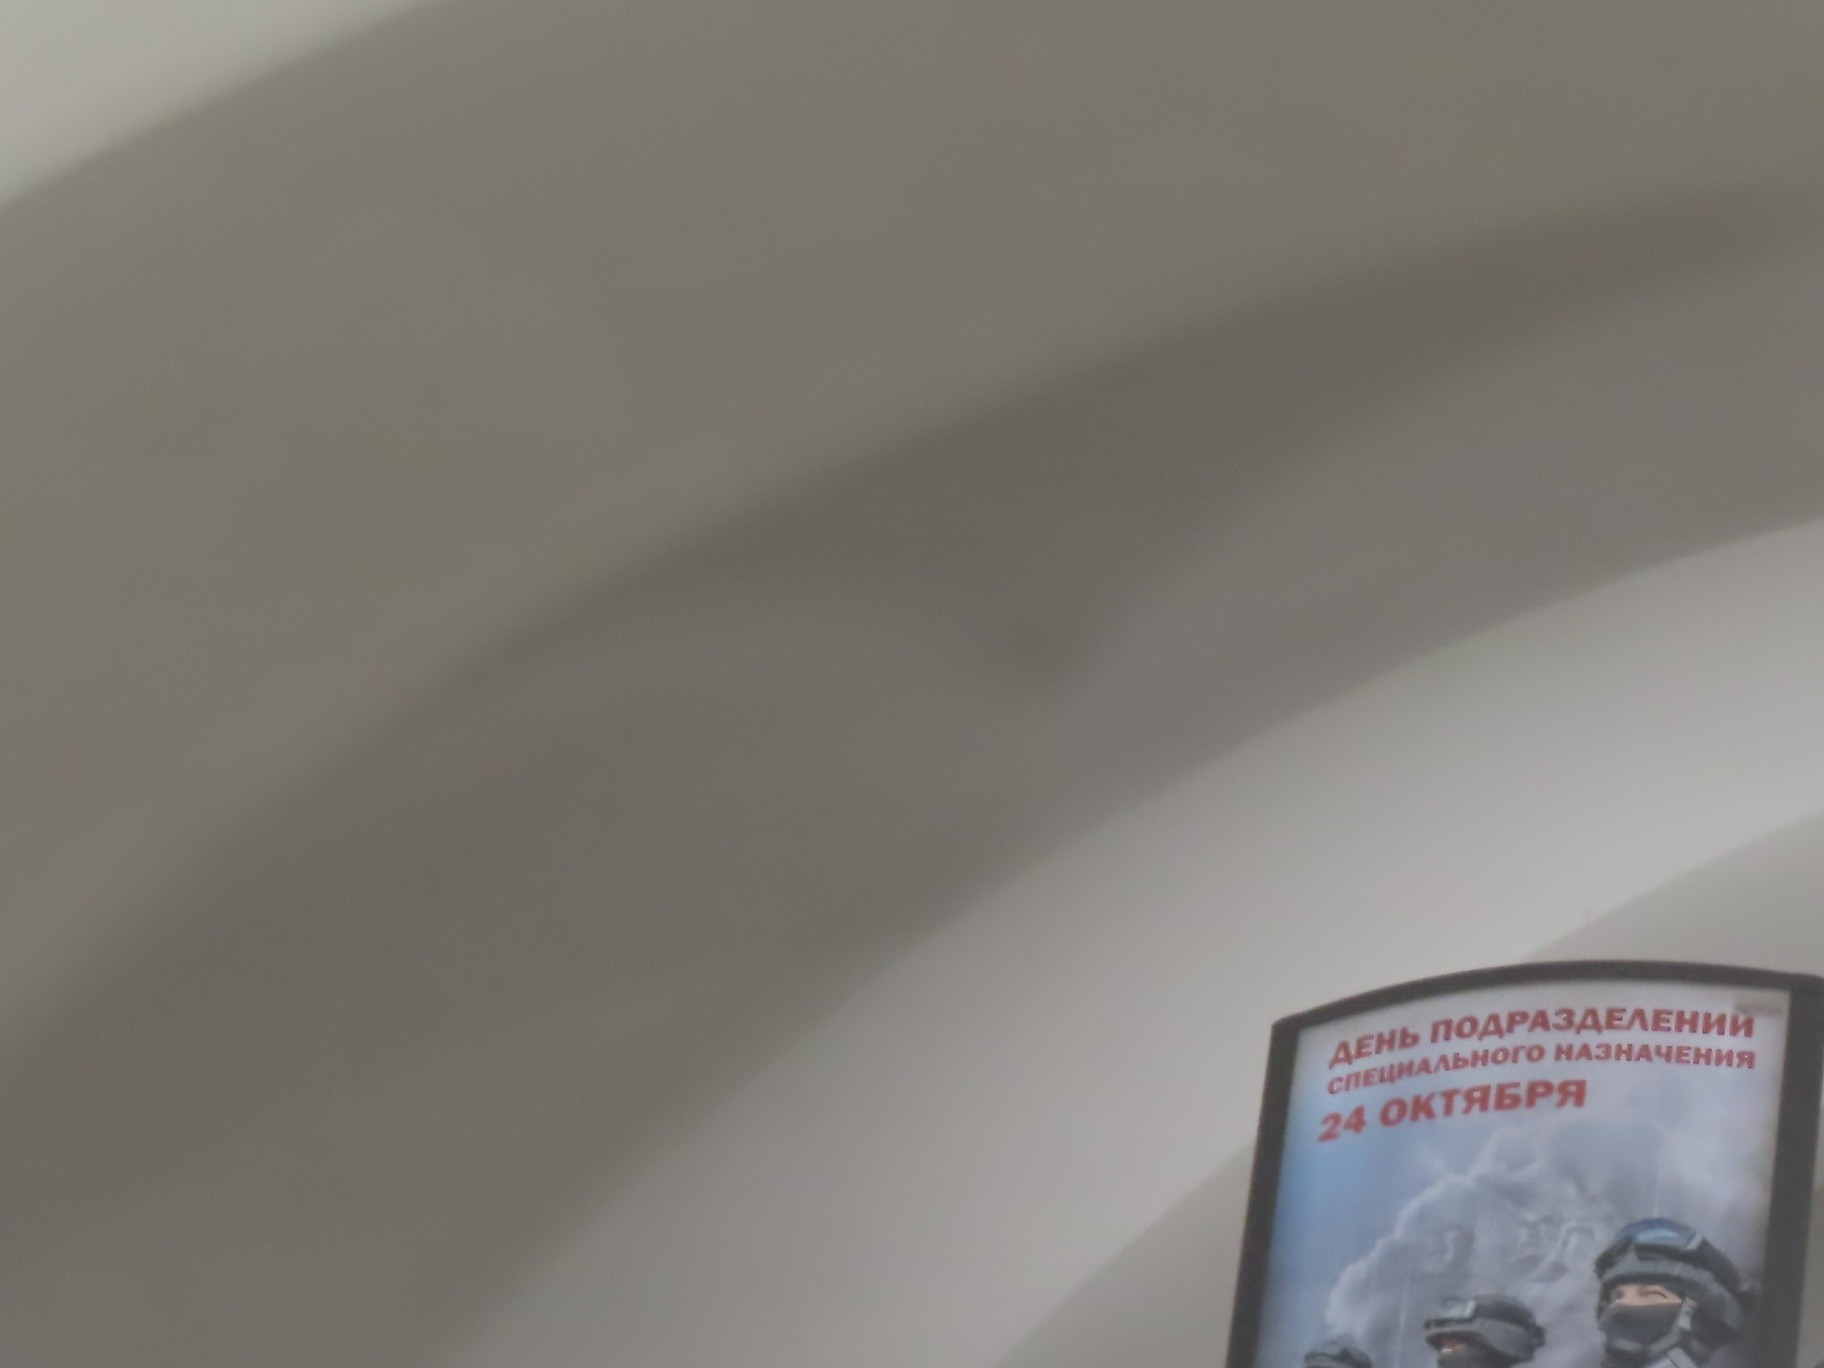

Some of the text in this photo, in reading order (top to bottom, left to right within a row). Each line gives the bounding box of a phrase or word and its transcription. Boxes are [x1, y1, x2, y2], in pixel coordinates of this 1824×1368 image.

[1327, 1042, 1756, 1096] СПЕЦИАЛЬНОГО НАЗНАЧЕНИЯ
[1329, 1026, 1421, 1069] ДЕНЬ
[1318, 1079, 1587, 1143] 24 ОКТЯБРЯ
